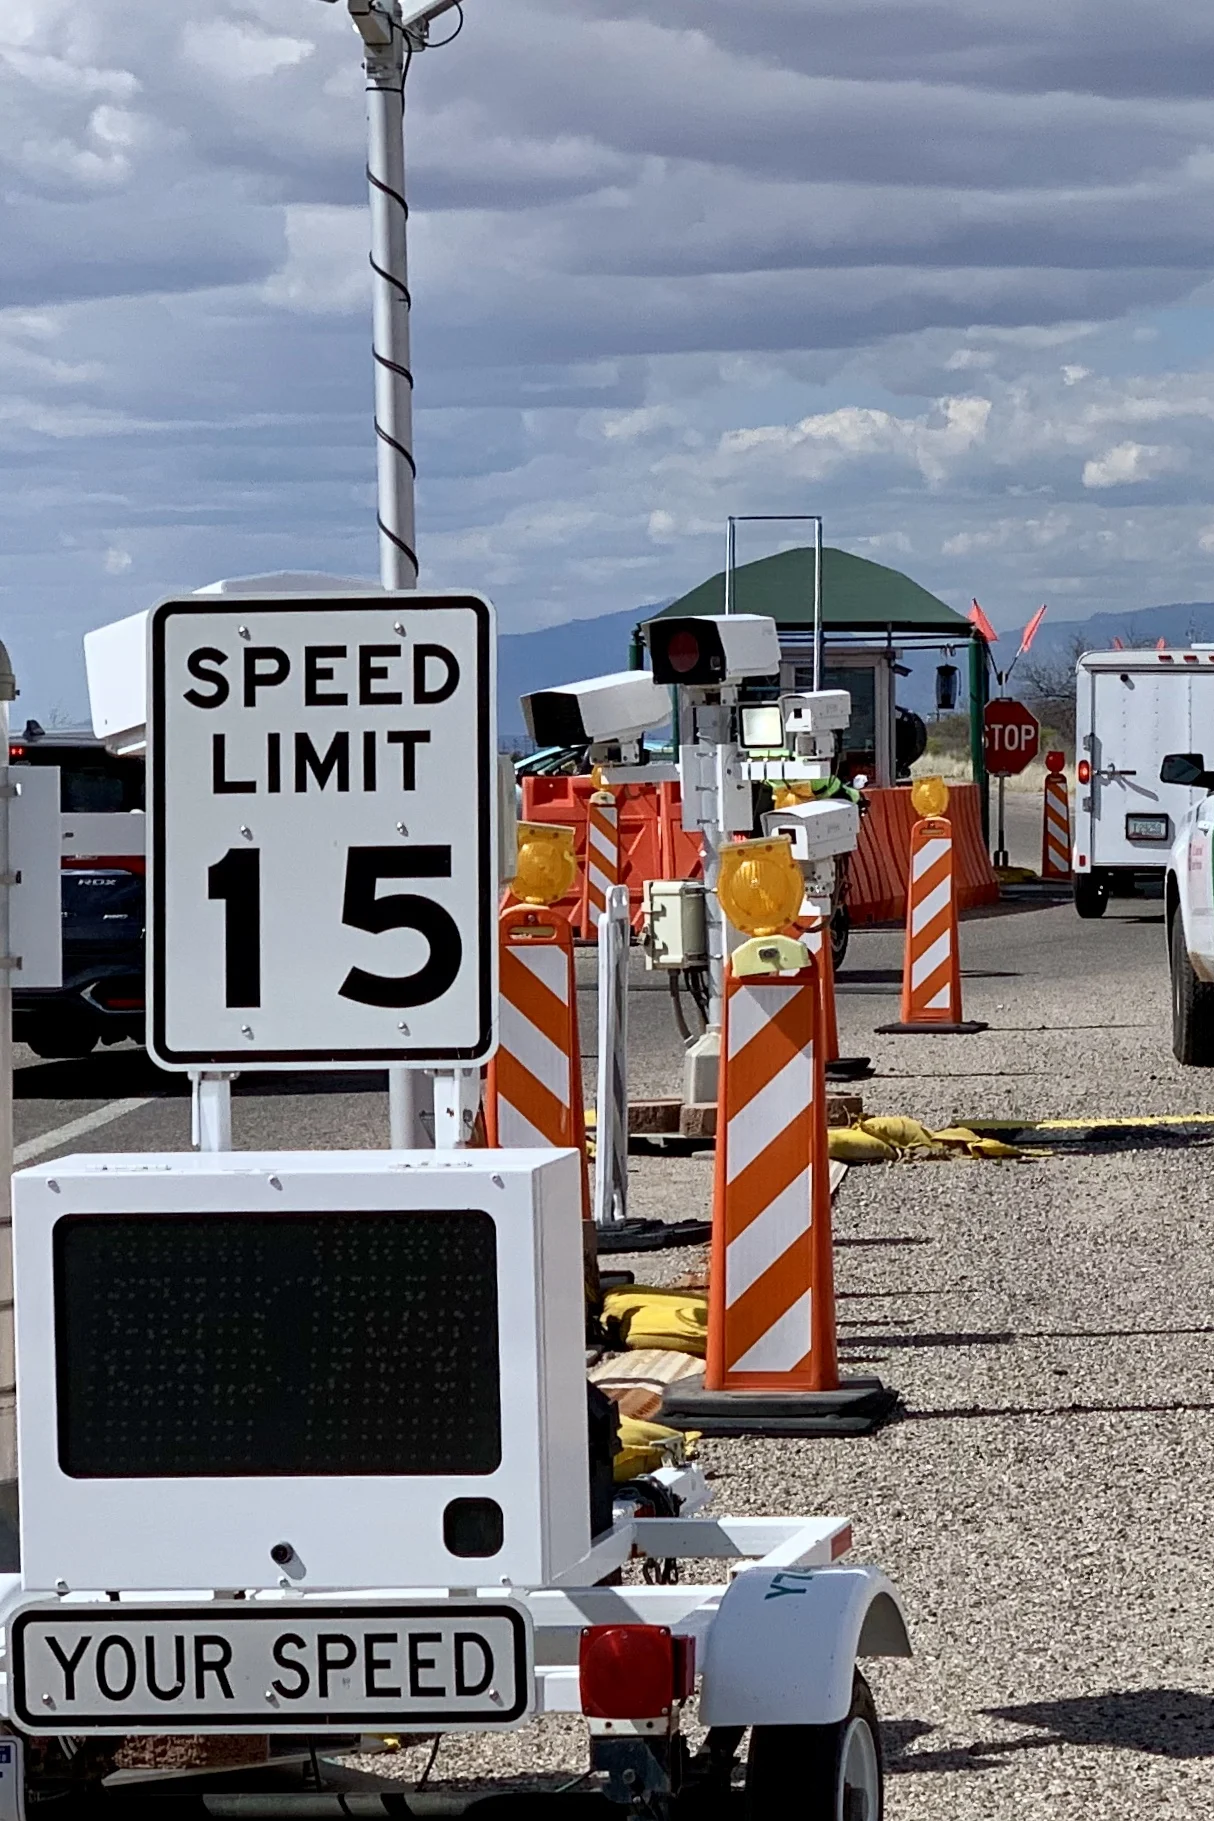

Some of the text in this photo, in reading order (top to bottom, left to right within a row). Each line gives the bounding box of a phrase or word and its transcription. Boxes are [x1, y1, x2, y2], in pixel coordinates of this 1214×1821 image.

[183, 644, 459, 709] SPEED
[213, 730, 430, 794] LIMIT
[208, 845, 462, 1008] 15
[764, 1568, 813, 1600] Y7
[45, 1632, 494, 1701] YOUR SPEED
